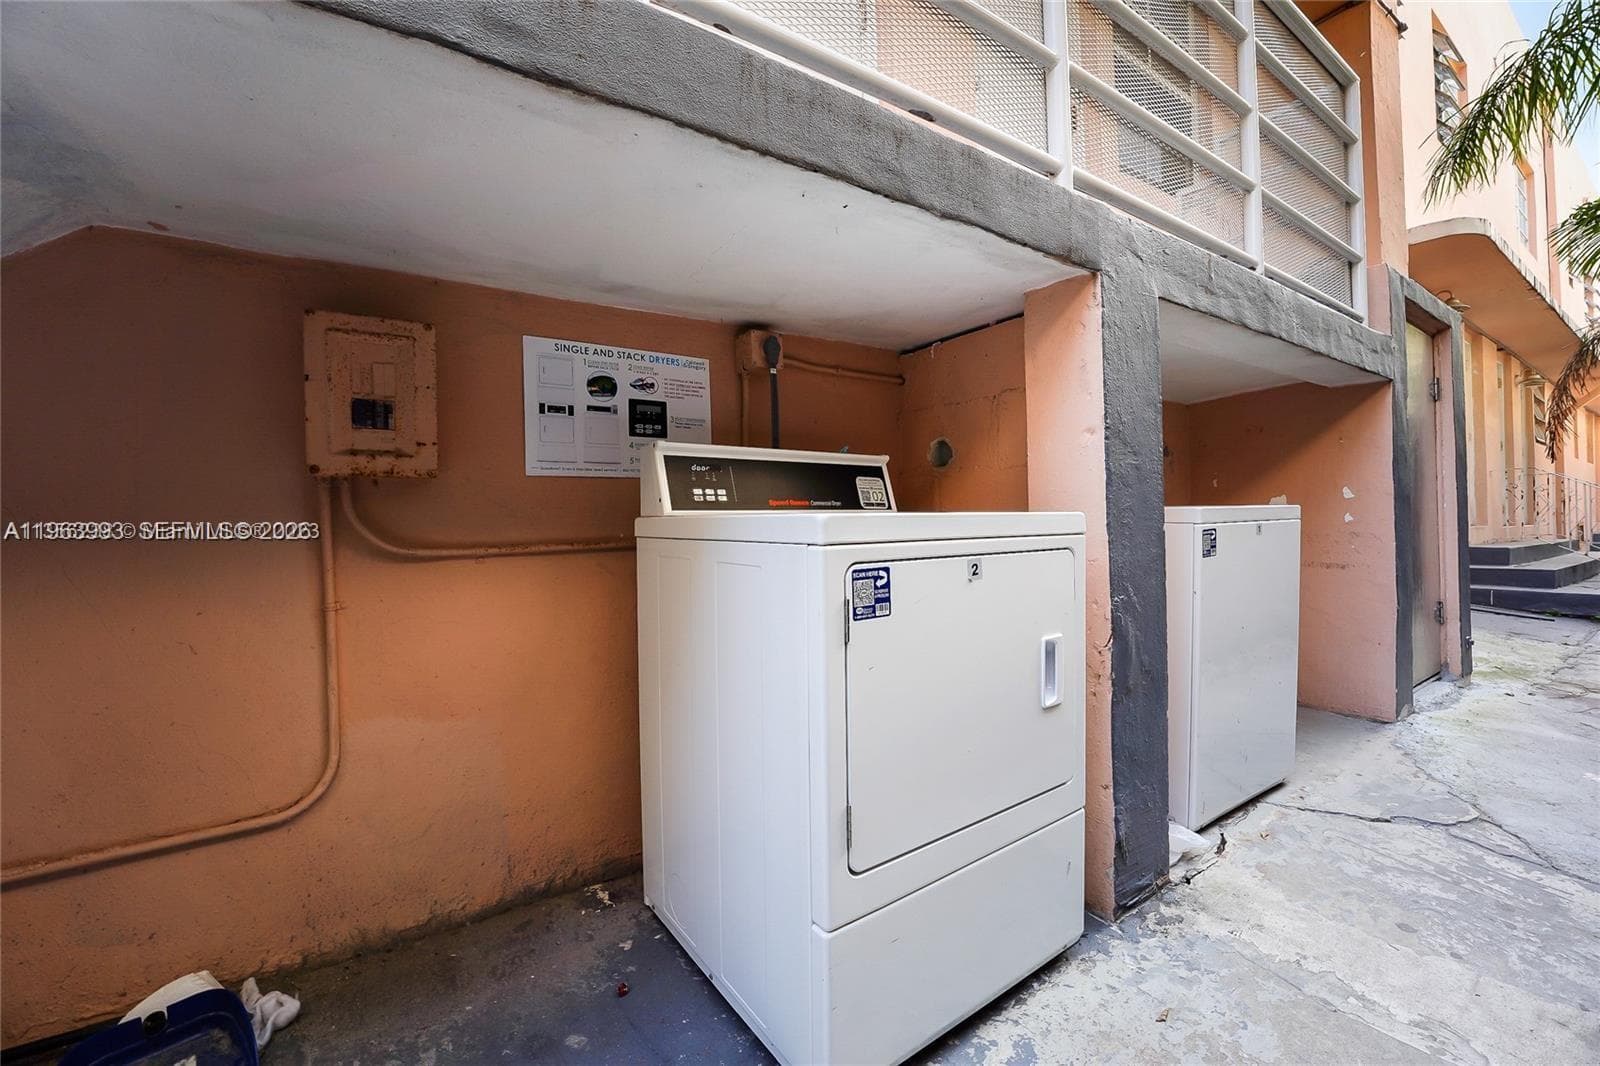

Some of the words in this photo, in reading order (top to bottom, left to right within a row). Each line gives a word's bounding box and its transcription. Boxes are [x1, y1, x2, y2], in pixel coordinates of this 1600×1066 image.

[554, 342, 590, 356] SINGLE
[592, 347, 614, 358] AND
[616, 350, 646, 362] STACK
[648, 354, 681, 367] DRYERS
[628, 363, 633, 371] 2
[629, 441, 635, 449] 4
[630, 456, 635, 465] 5
[872, 491, 884, 502] 02
[970, 563, 979, 577] 2
